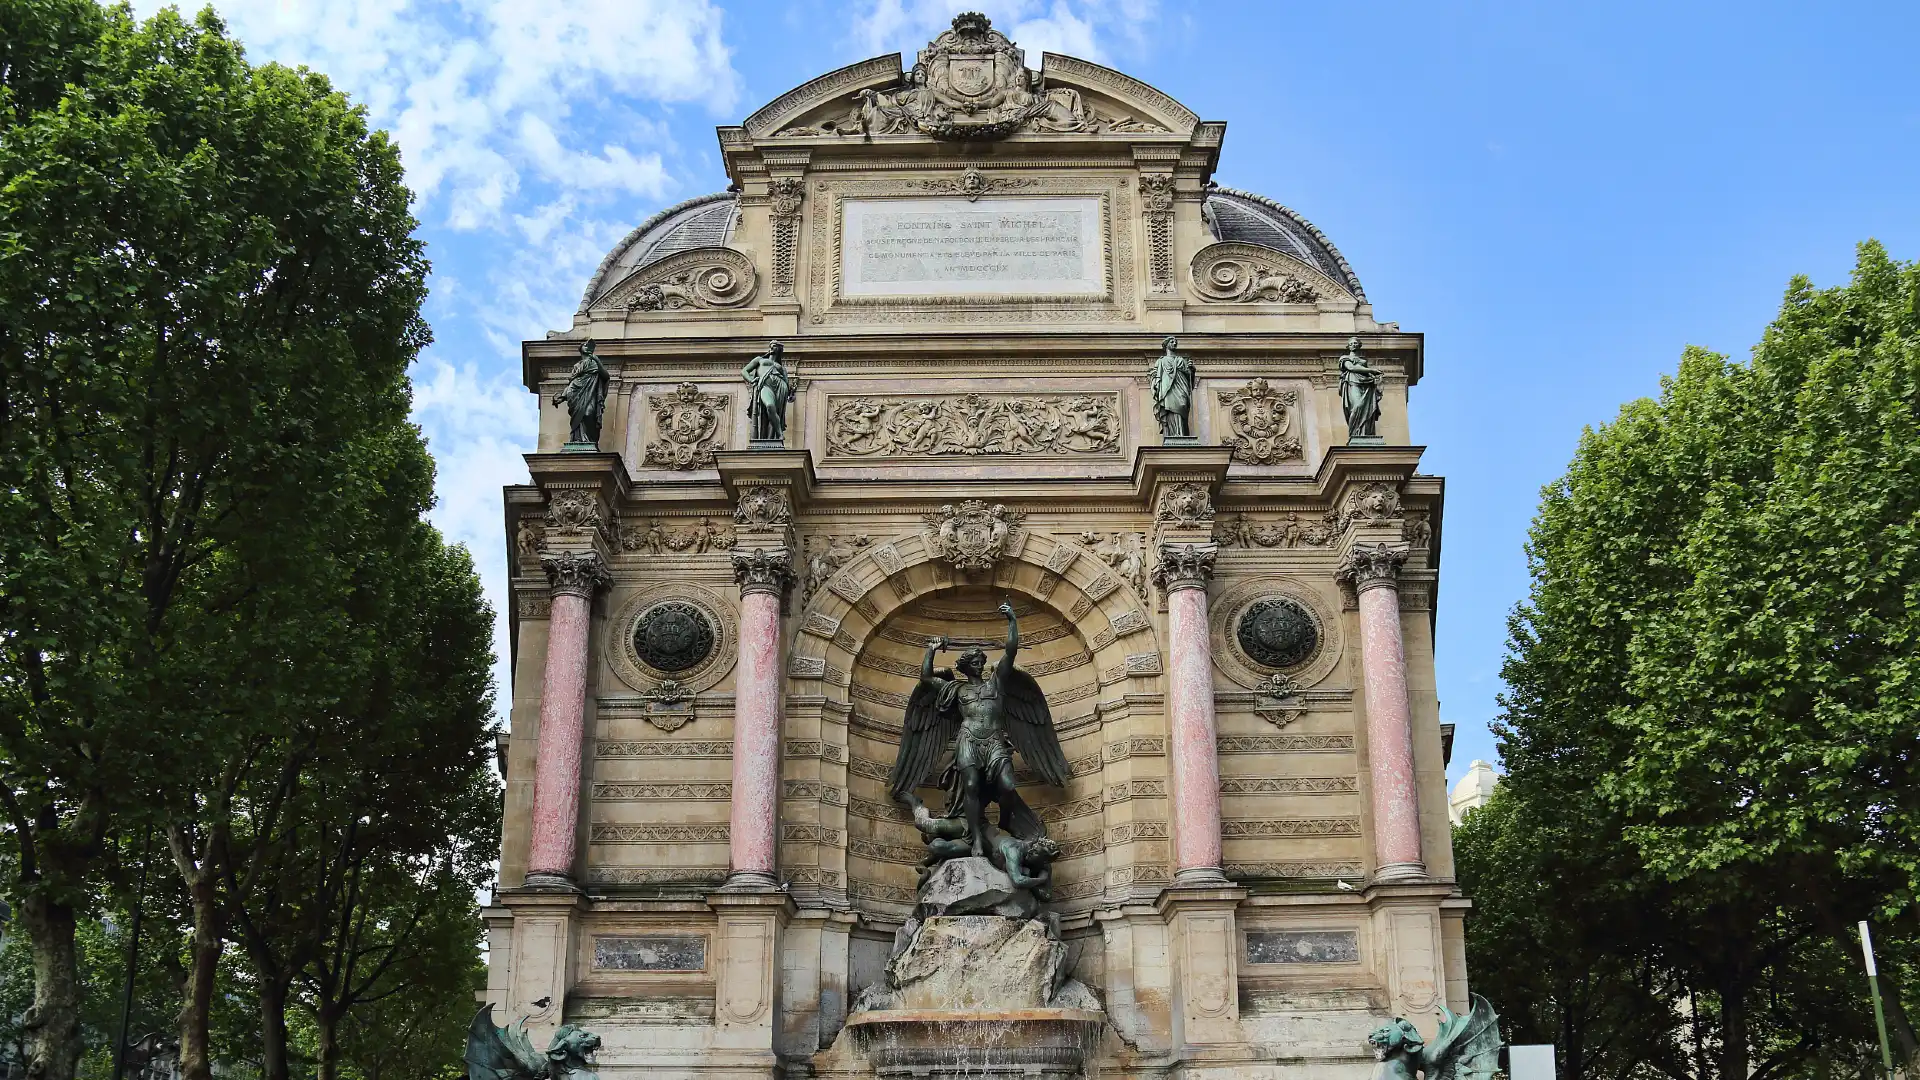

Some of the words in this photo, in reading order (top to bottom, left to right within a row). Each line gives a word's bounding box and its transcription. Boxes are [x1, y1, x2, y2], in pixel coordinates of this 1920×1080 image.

[897, 221, 952, 230] FONTAINE
[960, 221, 992, 230] SAINT
[999, 220, 1046, 229] MICHEL
[1052, 249, 1076, 257] PARIS
